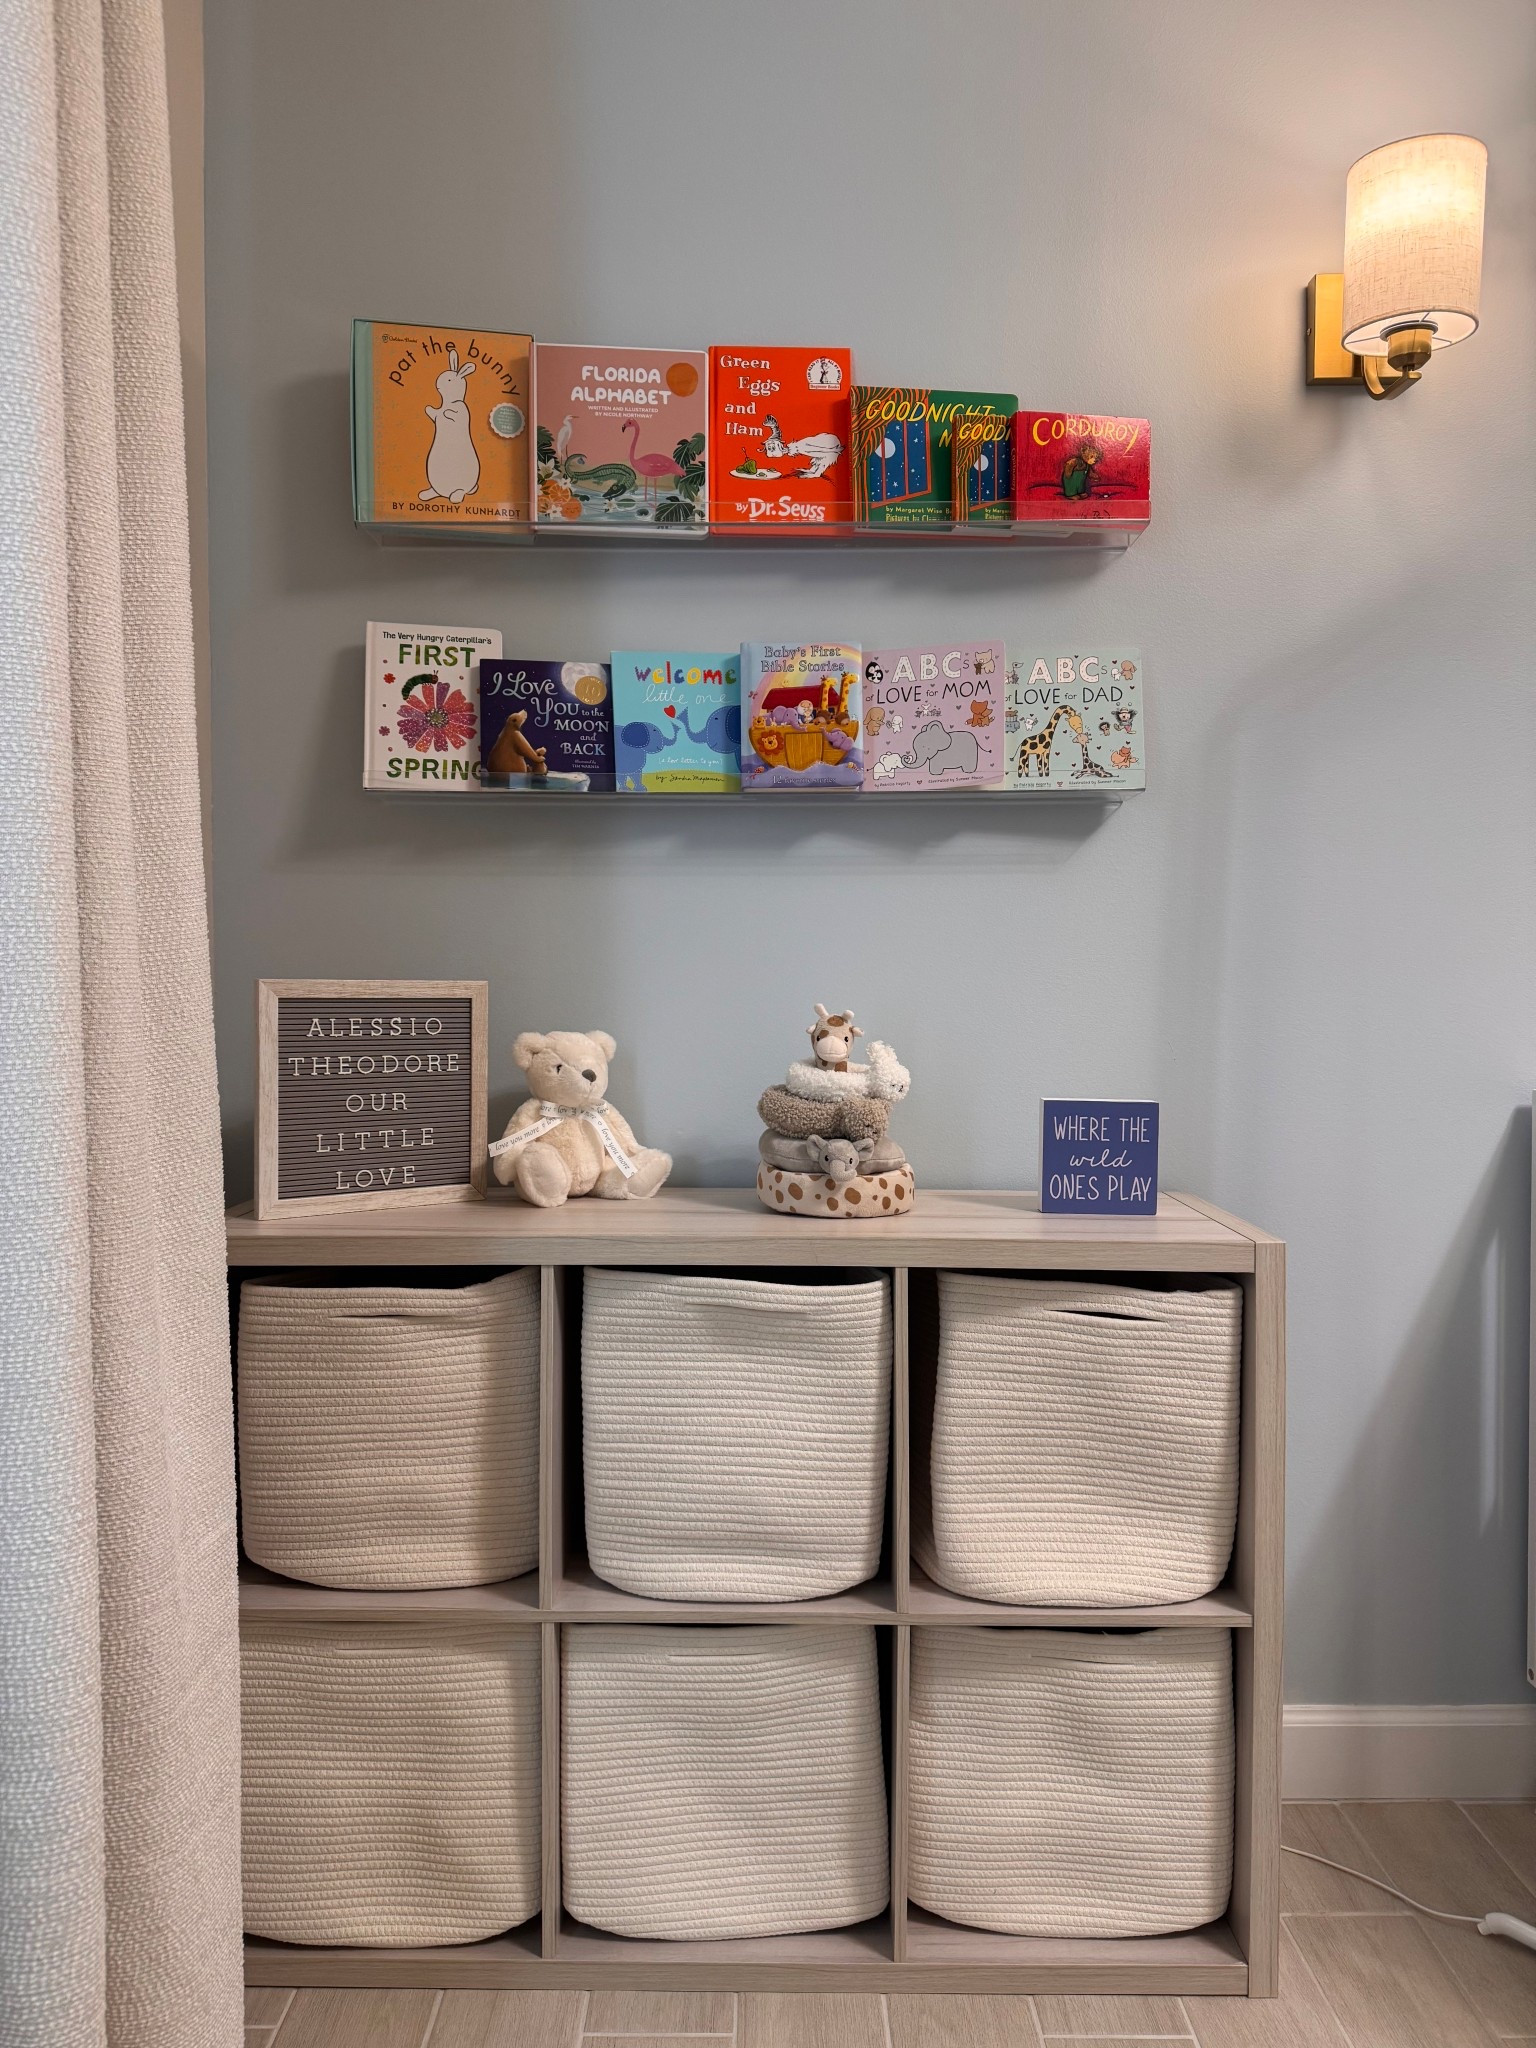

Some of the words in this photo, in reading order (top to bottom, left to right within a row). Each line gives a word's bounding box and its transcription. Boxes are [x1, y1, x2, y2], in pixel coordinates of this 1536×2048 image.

[389, 350, 417, 387] pat
[422, 336, 456, 356] the
[468, 339, 520, 397] bunny
[720, 355, 770, 370] Green
[582, 366, 660, 383] FLORIDA
[571, 386, 672, 405] ALPHABET
[739, 376, 780, 396] Eggs
[725, 402, 756, 414] and
[726, 423, 763, 436] Ham
[1032, 417, 1139, 456] CORDUROY
[409, 503, 460, 513] DOROTHY
[465, 506, 521, 517] KUNHARDT
[736, 503, 748, 514] By
[748, 498, 776, 518] Dr.
[778, 496, 826, 520] Seuss
[398, 633, 414, 642] Very
[417, 634, 444, 643] Hungry
[446, 635, 492, 644] Caterpillar's
[399, 644, 475, 667] FIRST
[764, 646, 806, 660] Baby's
[810, 645, 841, 657] First
[635, 661, 736, 685] welcome
[761, 660, 794, 673] Bible
[799, 660, 845, 672] Stories
[487, 672, 502, 695] I
[865, 694, 874, 702] of
[877, 685, 921, 704] LOVE
[942, 680, 991, 699] MOM
[642, 684, 688, 703] little
[696, 694, 730, 704] one
[1014, 688, 1061, 705] LOVE
[1082, 686, 1123, 703] DAD
[591, 708, 604, 716] the
[554, 720, 609, 733] MOON
[580, 733, 596, 741] and
[560, 742, 606, 755] BACK
[773, 775, 782, 784] 12
[307, 1017, 442, 1037] ALESSIO
[288, 1054, 459, 1076] THEODORE
[346, 1092, 408, 1112] OUR
[1054, 1115, 1110, 1142] WHERE
[1119, 1116, 1150, 1142] THE
[316, 1128, 434, 1152] LITTLE
[495, 1142, 509, 1151] love
[524, 1127, 539, 1139] more
[602, 1128, 610, 1141] love
[606, 1142, 618, 1154] you
[617, 1156, 630, 1169] more
[1070, 1148, 1132, 1167] wild
[336, 1166, 416, 1190] LOVE
[1050, 1174, 1099, 1200] ONES
[1108, 1175, 1151, 1202] PLAY
